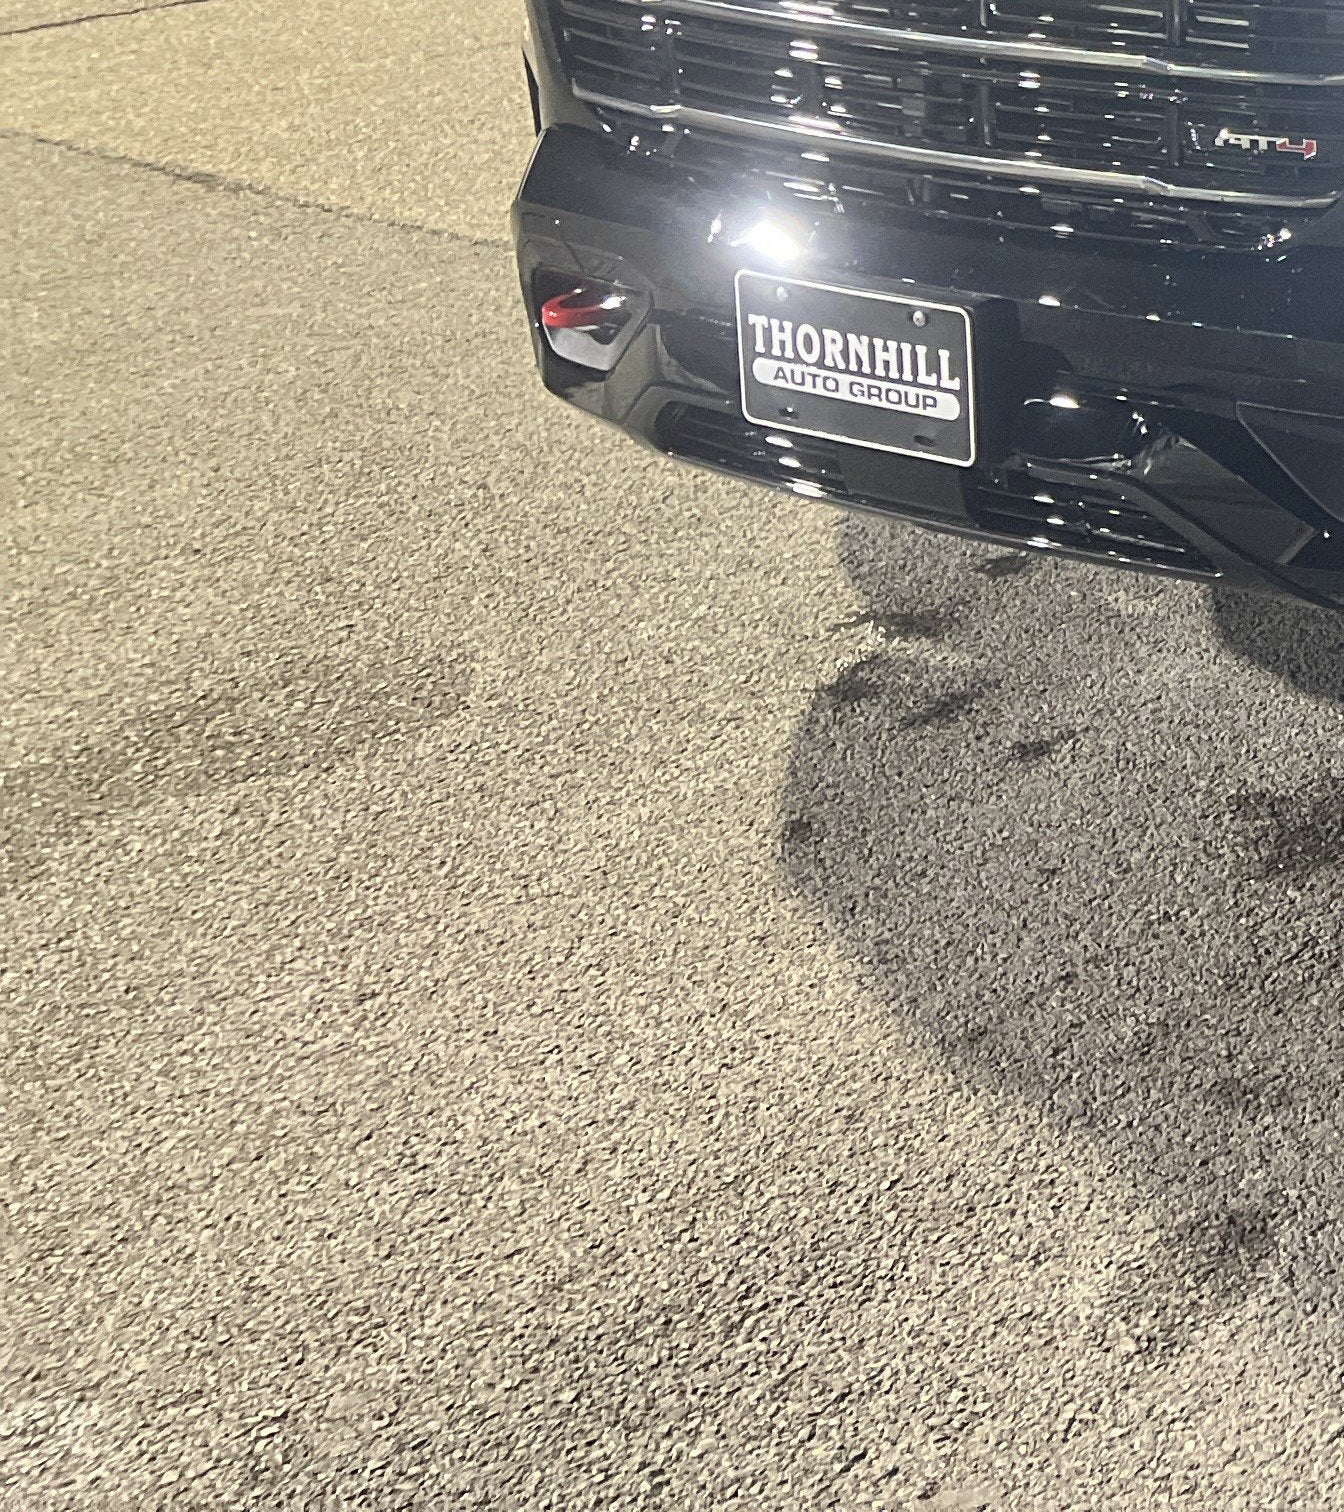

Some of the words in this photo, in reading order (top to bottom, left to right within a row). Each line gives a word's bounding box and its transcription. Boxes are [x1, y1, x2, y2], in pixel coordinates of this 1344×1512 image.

[1214, 127, 1318, 160] AT4
[747, 313, 961, 391] THORNHILL
[773, 366, 840, 393] AUTO
[849, 381, 938, 411] GROUP
